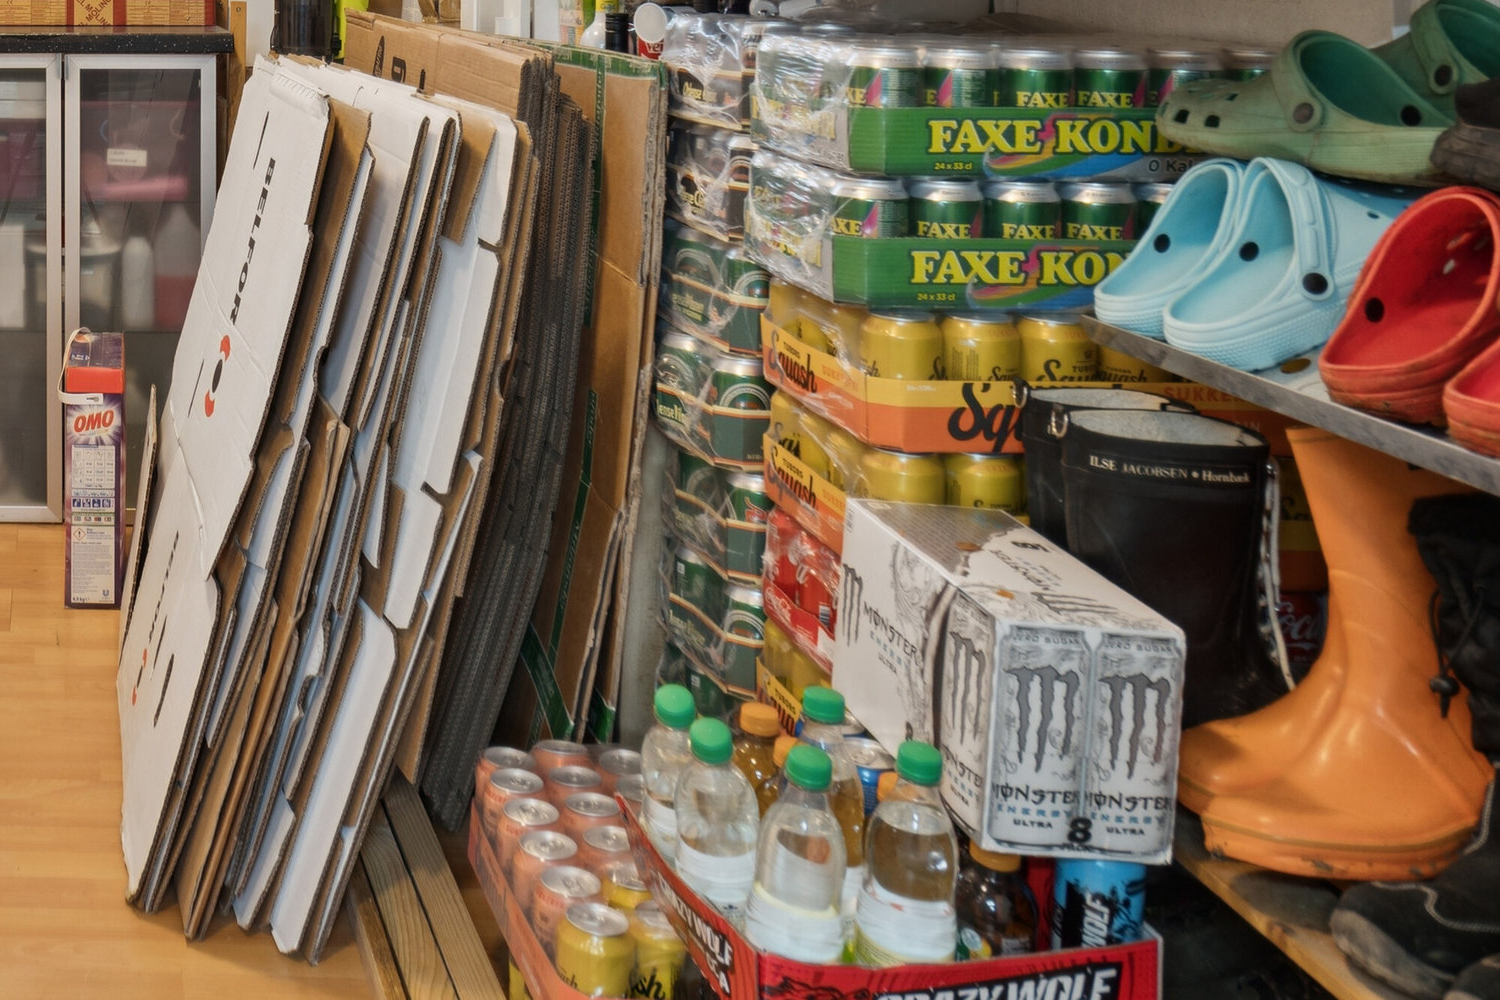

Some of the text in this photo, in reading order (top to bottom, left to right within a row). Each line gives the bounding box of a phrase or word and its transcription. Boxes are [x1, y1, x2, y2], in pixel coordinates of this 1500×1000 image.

[1016, 91, 1068, 108] FAXE
[1078, 91, 1133, 108] FAXE
[928, 119, 1042, 154] FAXE
[918, 220, 971, 239] FAXE
[1002, 222, 1055, 239] FAXE
[1067, 222, 1123, 240] FAXE
[229, 157, 276, 326] BELFOR
[910, 250, 1026, 285] FAXE
[73, 409, 115, 433] OMO
[1090, 455, 1117, 473] ILSE
[1122, 462, 1188, 480] JACOBSEN
[1013, 818, 1053, 829] ULTRA
[1067, 816, 1093, 844] 8
[1106, 825, 1145, 836] ULTRA
